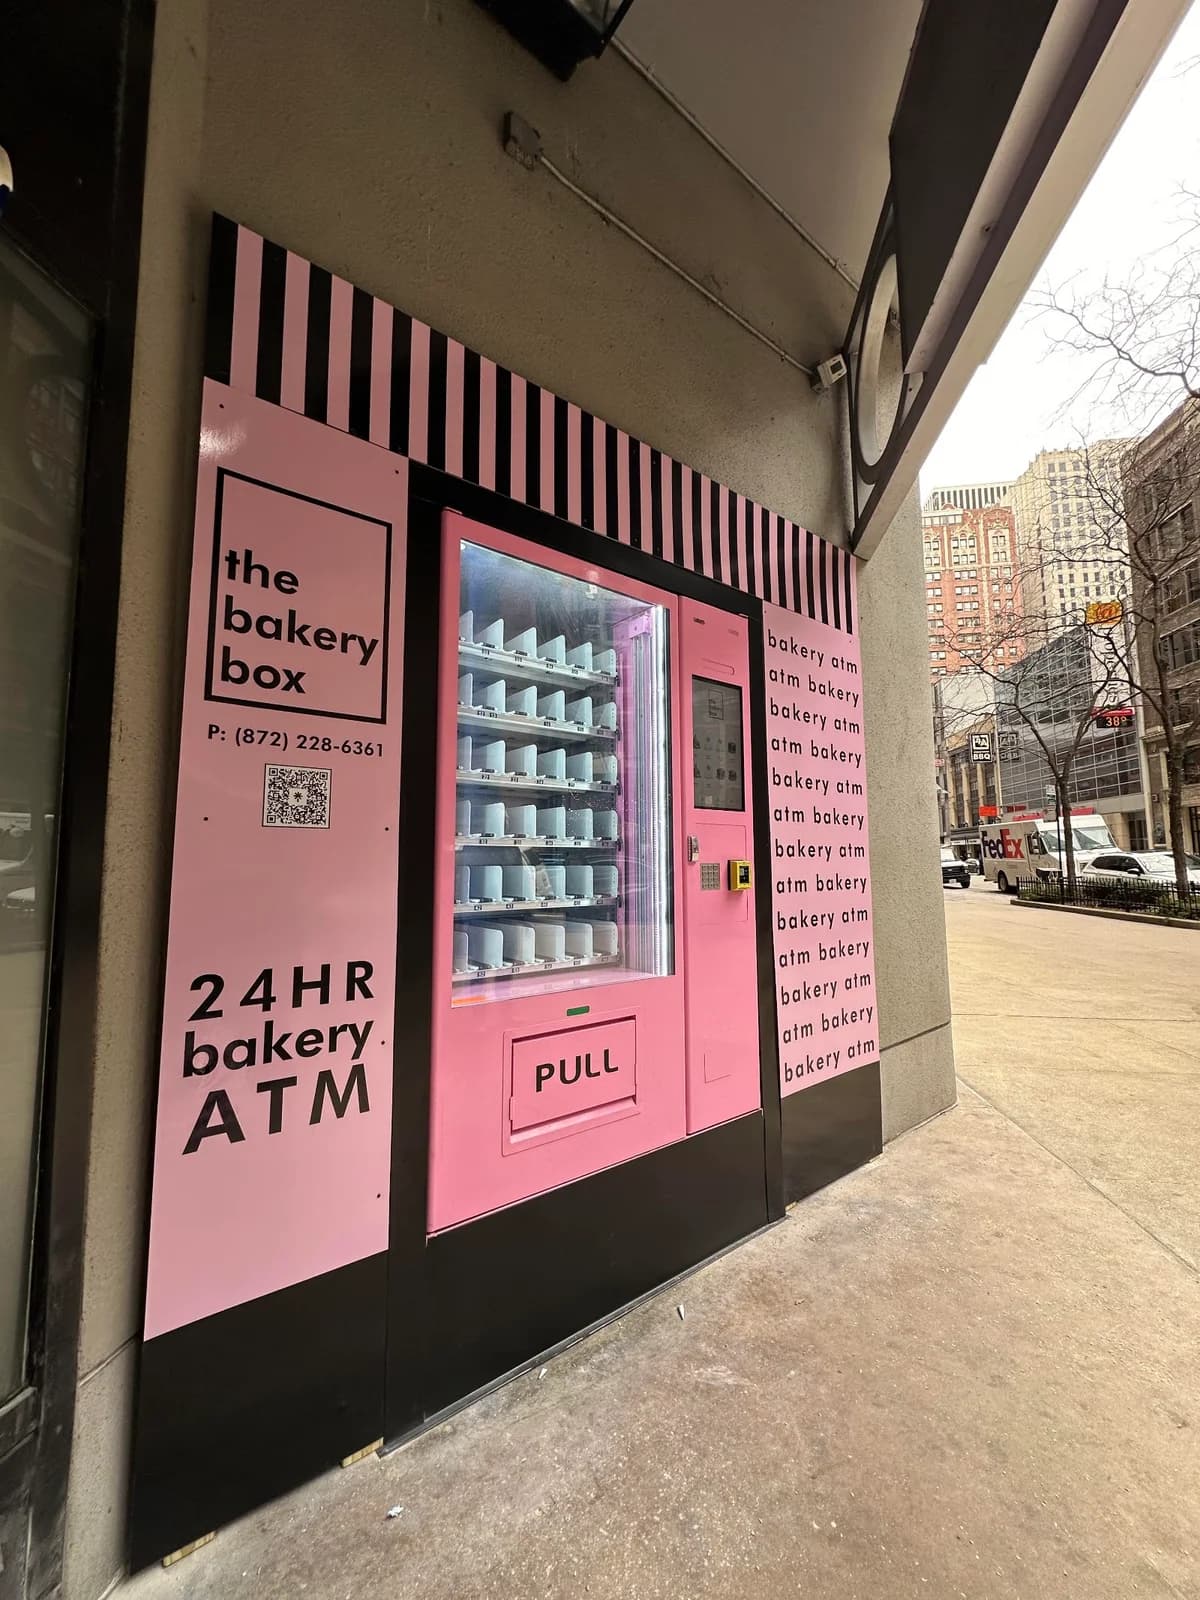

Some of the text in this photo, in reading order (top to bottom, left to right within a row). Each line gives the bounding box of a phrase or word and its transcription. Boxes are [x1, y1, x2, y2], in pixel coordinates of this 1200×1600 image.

[225, 549, 299, 594] the
[223, 595, 379, 666] bakery
[221, 646, 306, 694] box
[768, 629, 858, 674] bakery atm
[770, 669, 859, 708] atm bakery
[771, 697, 860, 734] bakery atm
[207, 724, 383, 757] P: (872) 228-6361
[772, 737, 862, 769] atm bakery
[773, 767, 863, 796] bakery atm
[774, 806, 864, 831] atm bakery
[775, 839, 865, 862] bakery atm
[981, 828, 1025, 859] FedEx
[777, 874, 867, 894] atm bakery
[778, 908, 868, 930] bakery atm
[779, 940, 870, 968] atm bakery
[781, 973, 871, 1006] bakery atm
[783, 1006, 873, 1044] atm bakery
[182, 1020, 374, 1078] bakery
[785, 1040, 875, 1083] bakery atm
[535, 1048, 619, 1093] PULL
[182, 1063, 370, 1156] ATM
